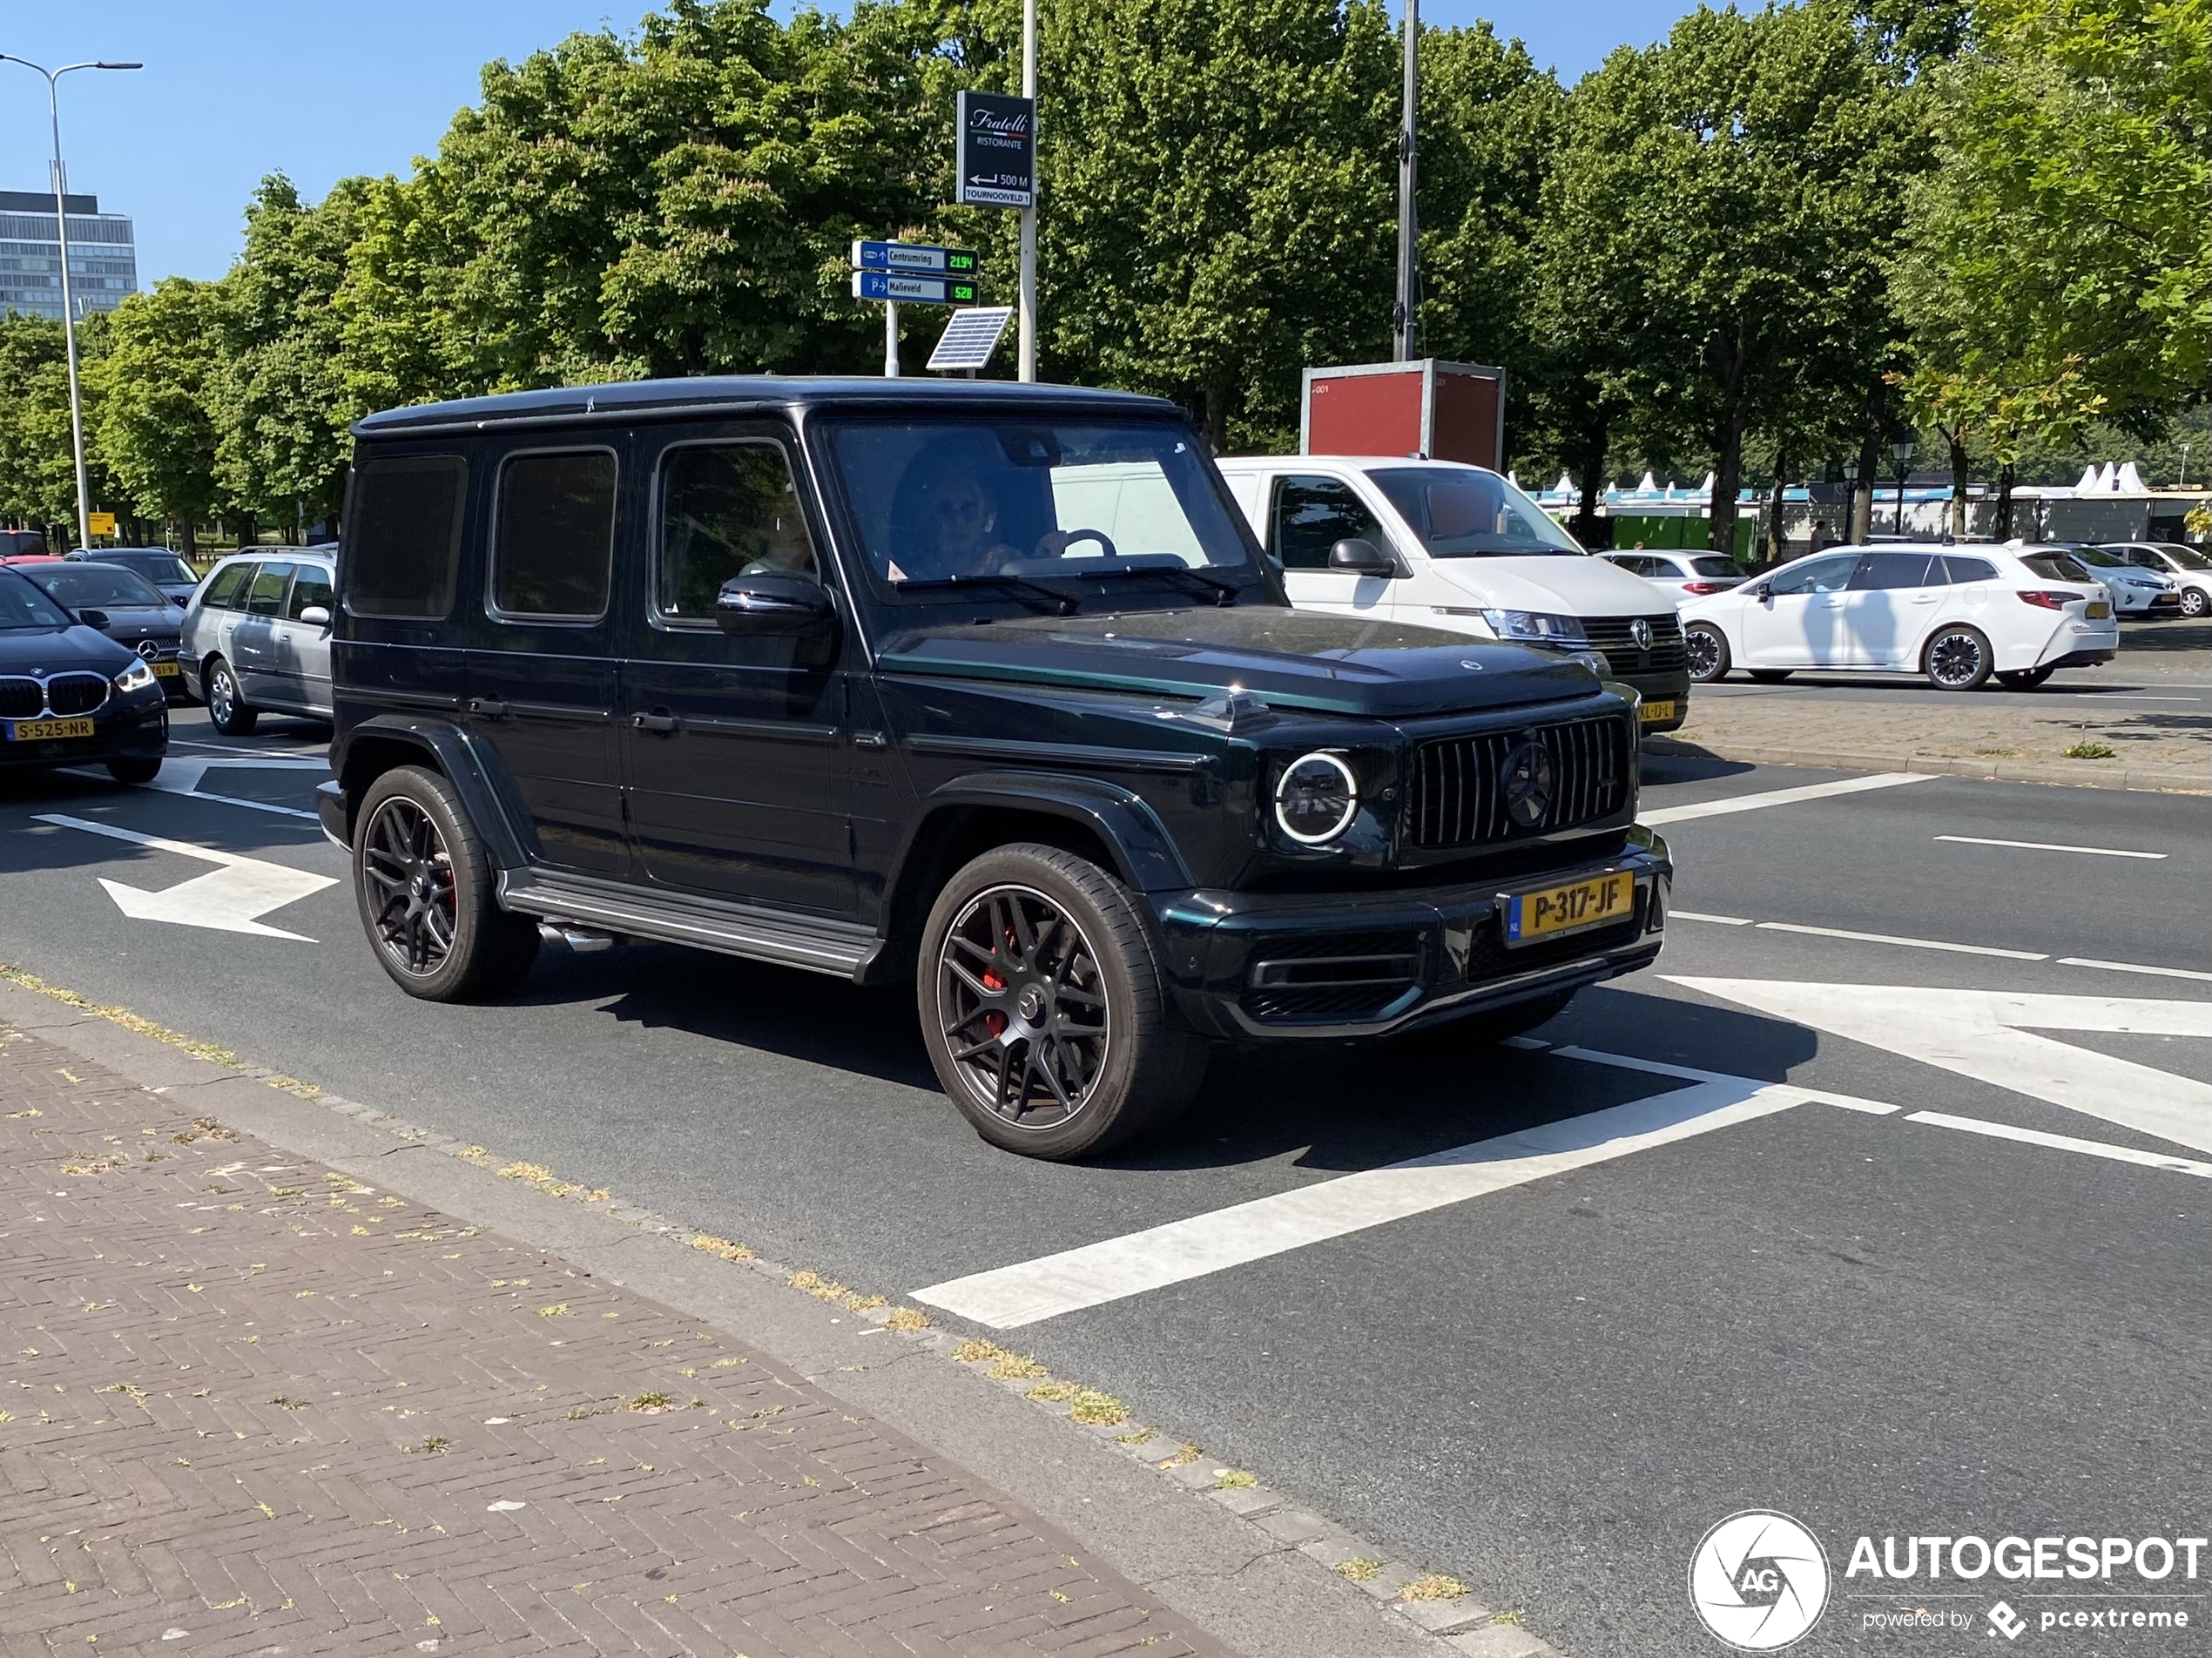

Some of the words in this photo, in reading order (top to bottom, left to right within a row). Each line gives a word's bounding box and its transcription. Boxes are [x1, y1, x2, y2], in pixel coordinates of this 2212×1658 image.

[970, 109, 1027, 132] Fratelli
[977, 136, 1022, 150] RISTORANTE
[1000, 174, 1017, 186] 500
[1019, 176, 1028, 187] M
[967, 189, 1023, 202] TOURNOOIVELD
[889, 251, 932, 265] Centrumring
[949, 255, 973, 269] 2194
[889, 281, 921, 293] Malieveld
[954, 286, 973, 300] 528
[19, 721, 90, 738] S-525-NR
[1534, 878, 1620, 928] P-317-JF
